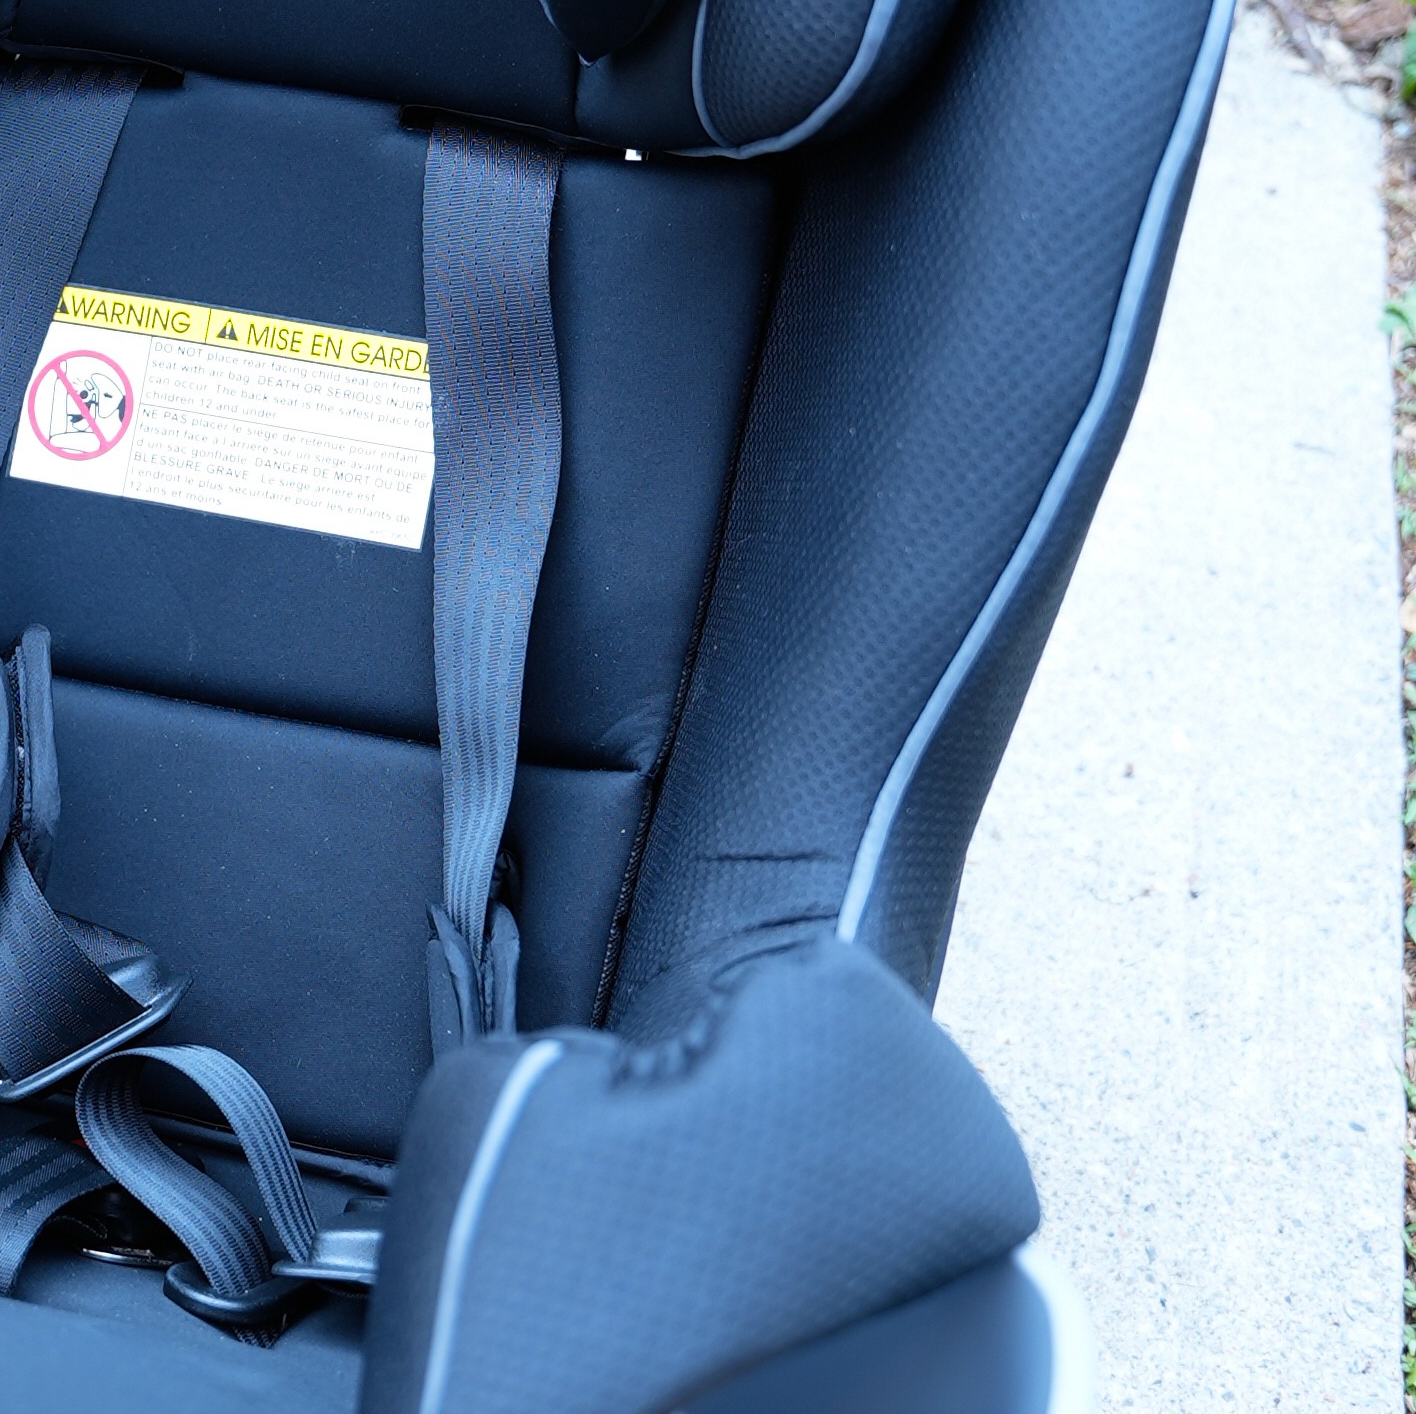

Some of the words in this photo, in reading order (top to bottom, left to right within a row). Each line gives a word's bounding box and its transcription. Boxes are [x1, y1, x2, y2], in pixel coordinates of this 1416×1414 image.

[72, 295, 191, 334] WARNING
[155, 342, 173, 353] DO
[178, 346, 203, 357] NOT
[247, 323, 304, 353] MISE
[310, 334, 343, 360] EN
[258, 375, 299, 391] DEATH
[304, 384, 322, 394] OR
[327, 387, 381, 404] SERIOUS
[387, 397, 431, 413] INJURY
[142, 408, 158, 419] NE
[164, 411, 187, 424] PAS
[134, 451, 201, 471] BLESSURE
[255, 458, 309, 474] DANGER
[313, 468, 329, 478] DE
[334, 471, 369, 484] MORT
[375, 478, 392, 489] OU
[397, 482, 412, 493] DE
